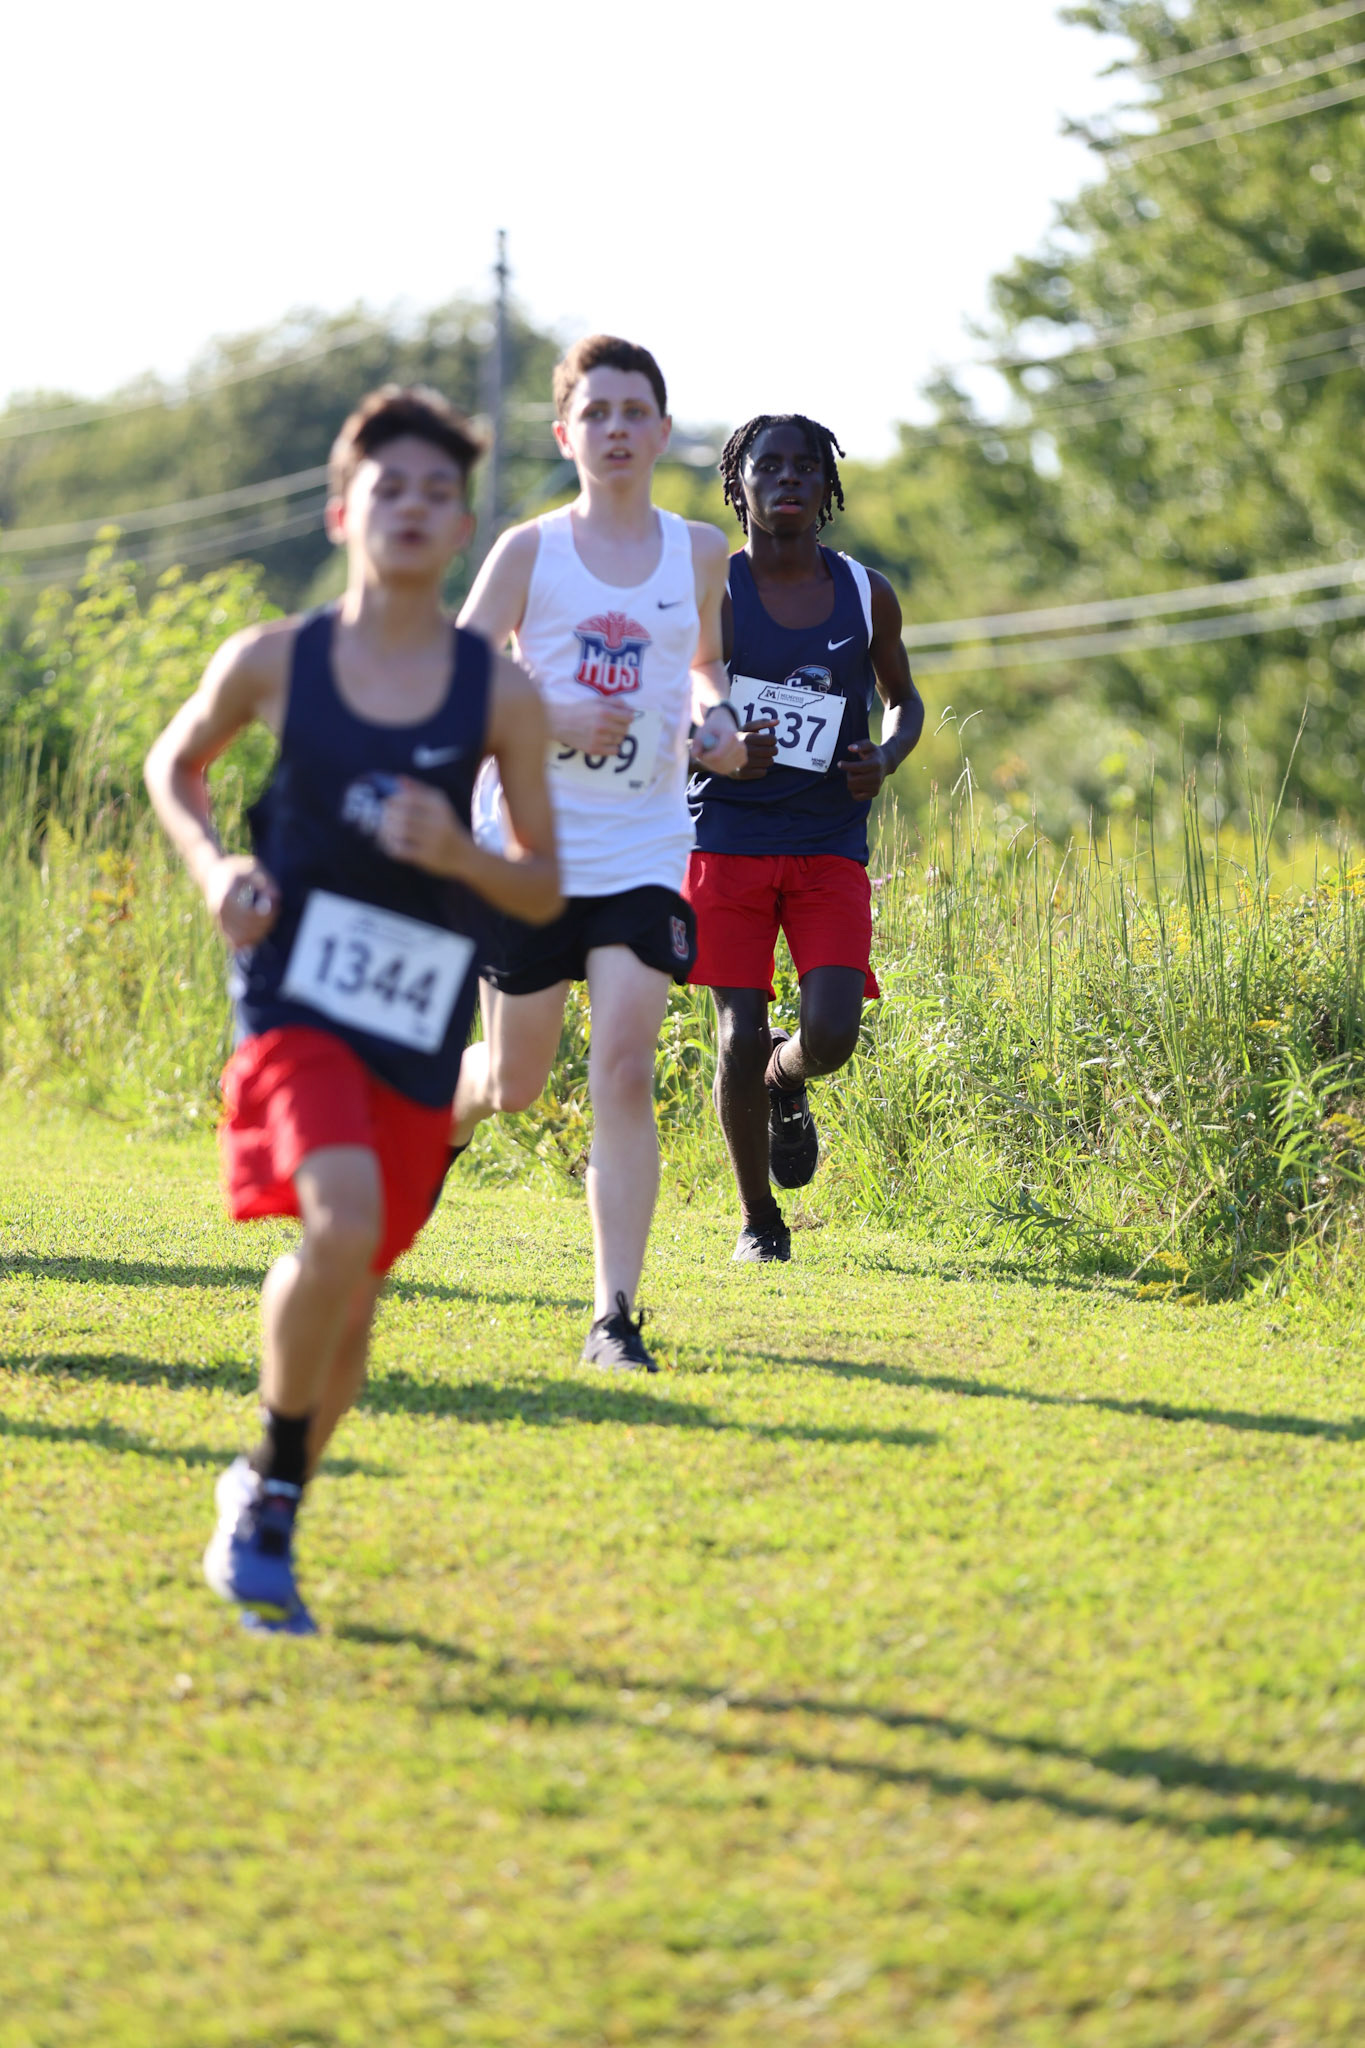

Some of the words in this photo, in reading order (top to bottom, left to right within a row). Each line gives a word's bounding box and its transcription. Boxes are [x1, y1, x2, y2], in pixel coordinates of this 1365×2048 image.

[583, 646, 637, 690] MUS
[765, 689, 776, 699] M
[315, 935, 438, 1015] 1344
